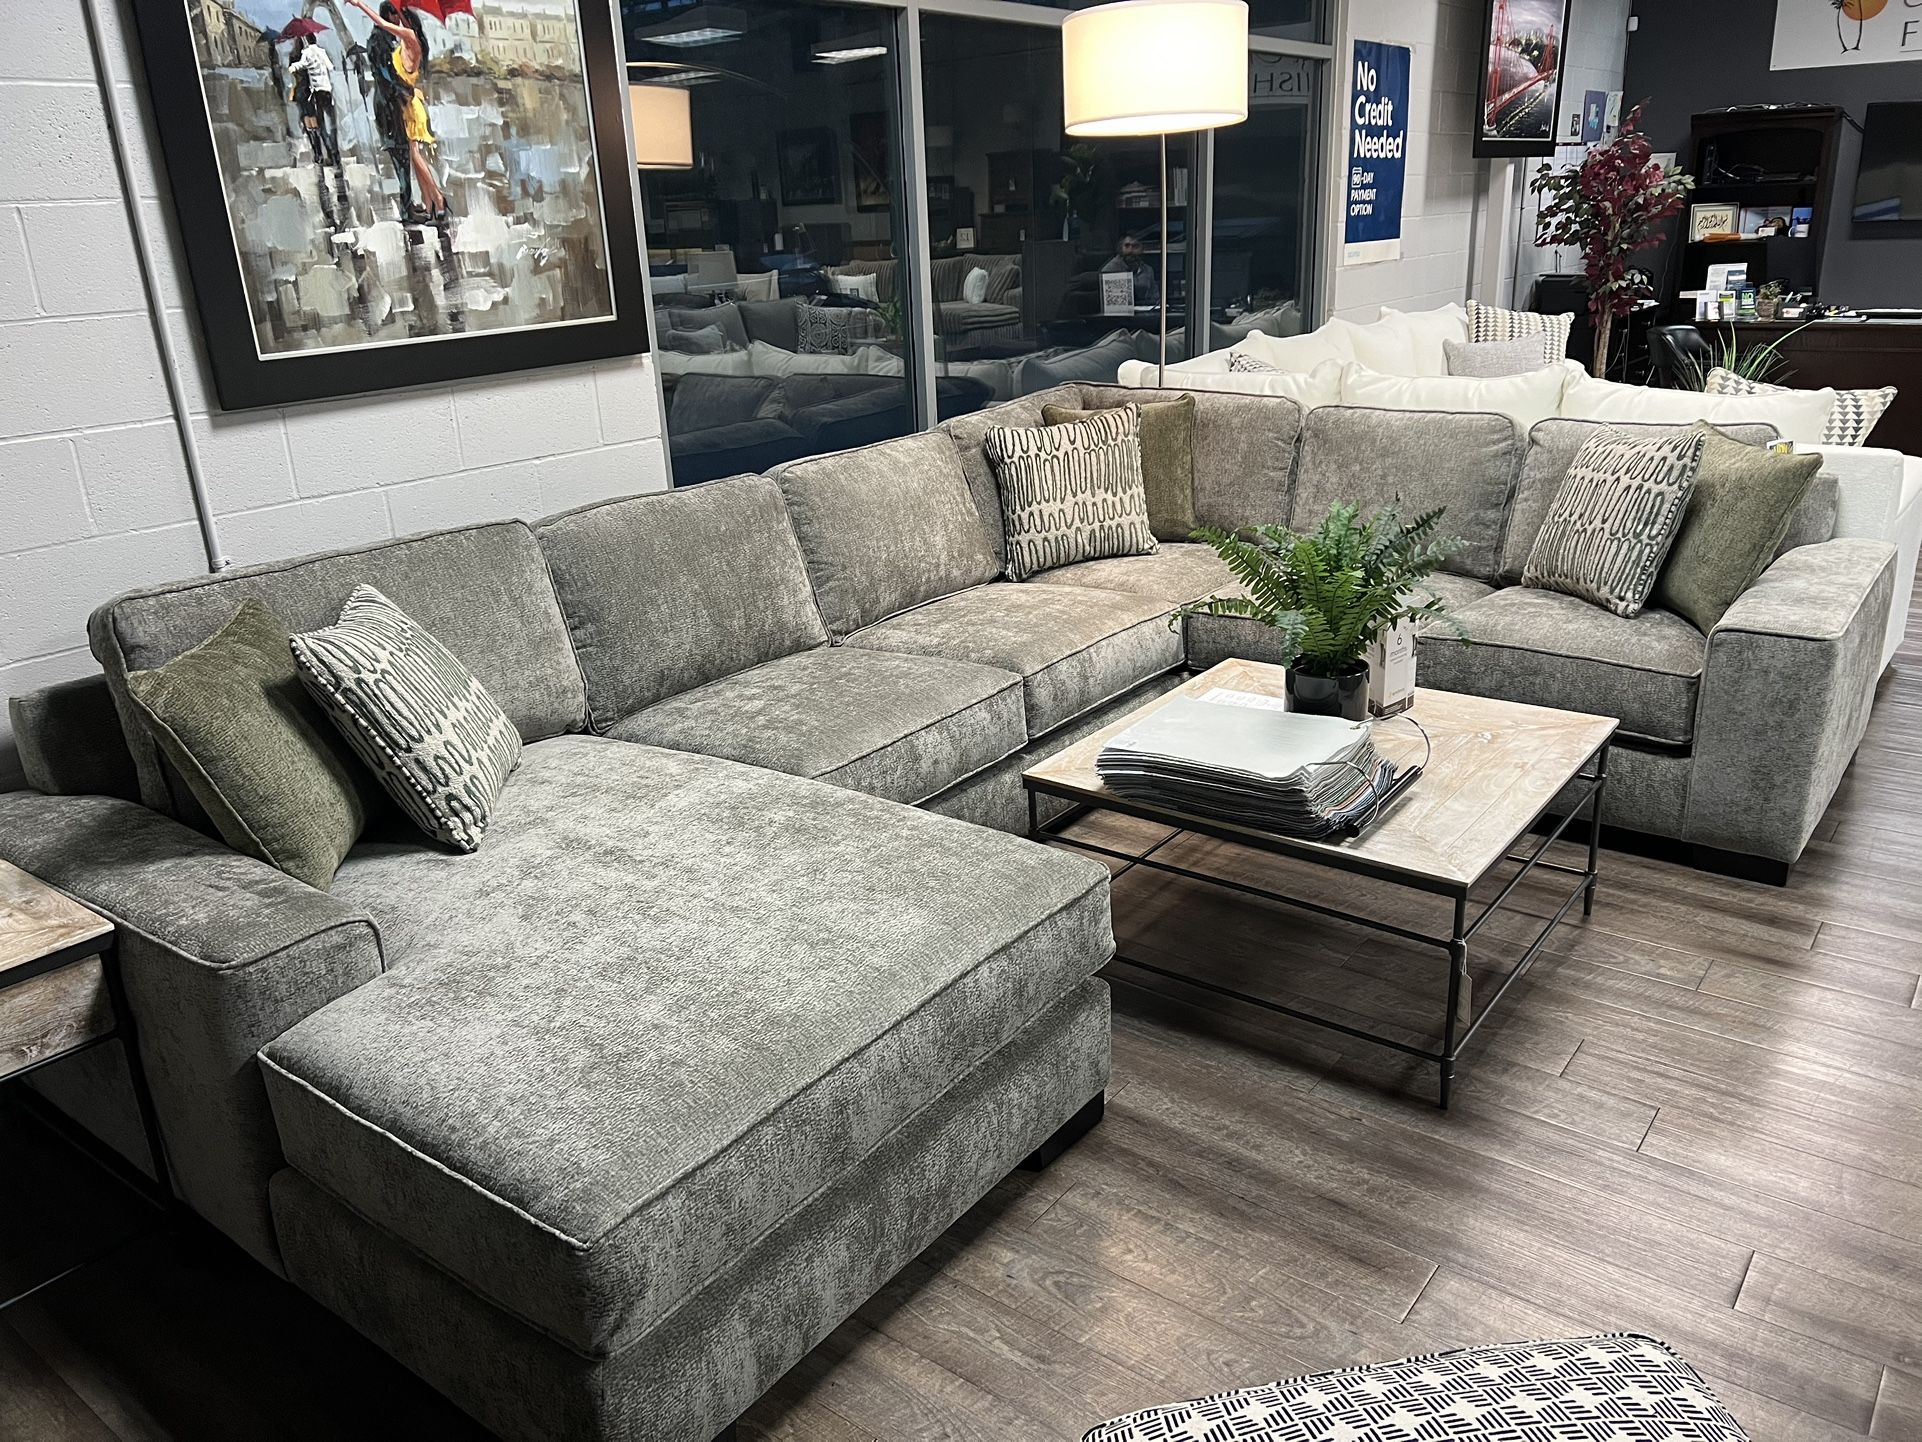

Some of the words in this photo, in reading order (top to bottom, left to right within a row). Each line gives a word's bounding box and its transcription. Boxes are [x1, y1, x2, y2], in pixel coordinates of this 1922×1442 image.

[1357, 60, 1377, 91] No
[1354, 95, 1393, 127] Credit
[1354, 129, 1404, 159] Needed
[1350, 188, 1377, 201] PAYMENT
[1350, 203, 1373, 217] OPTION
